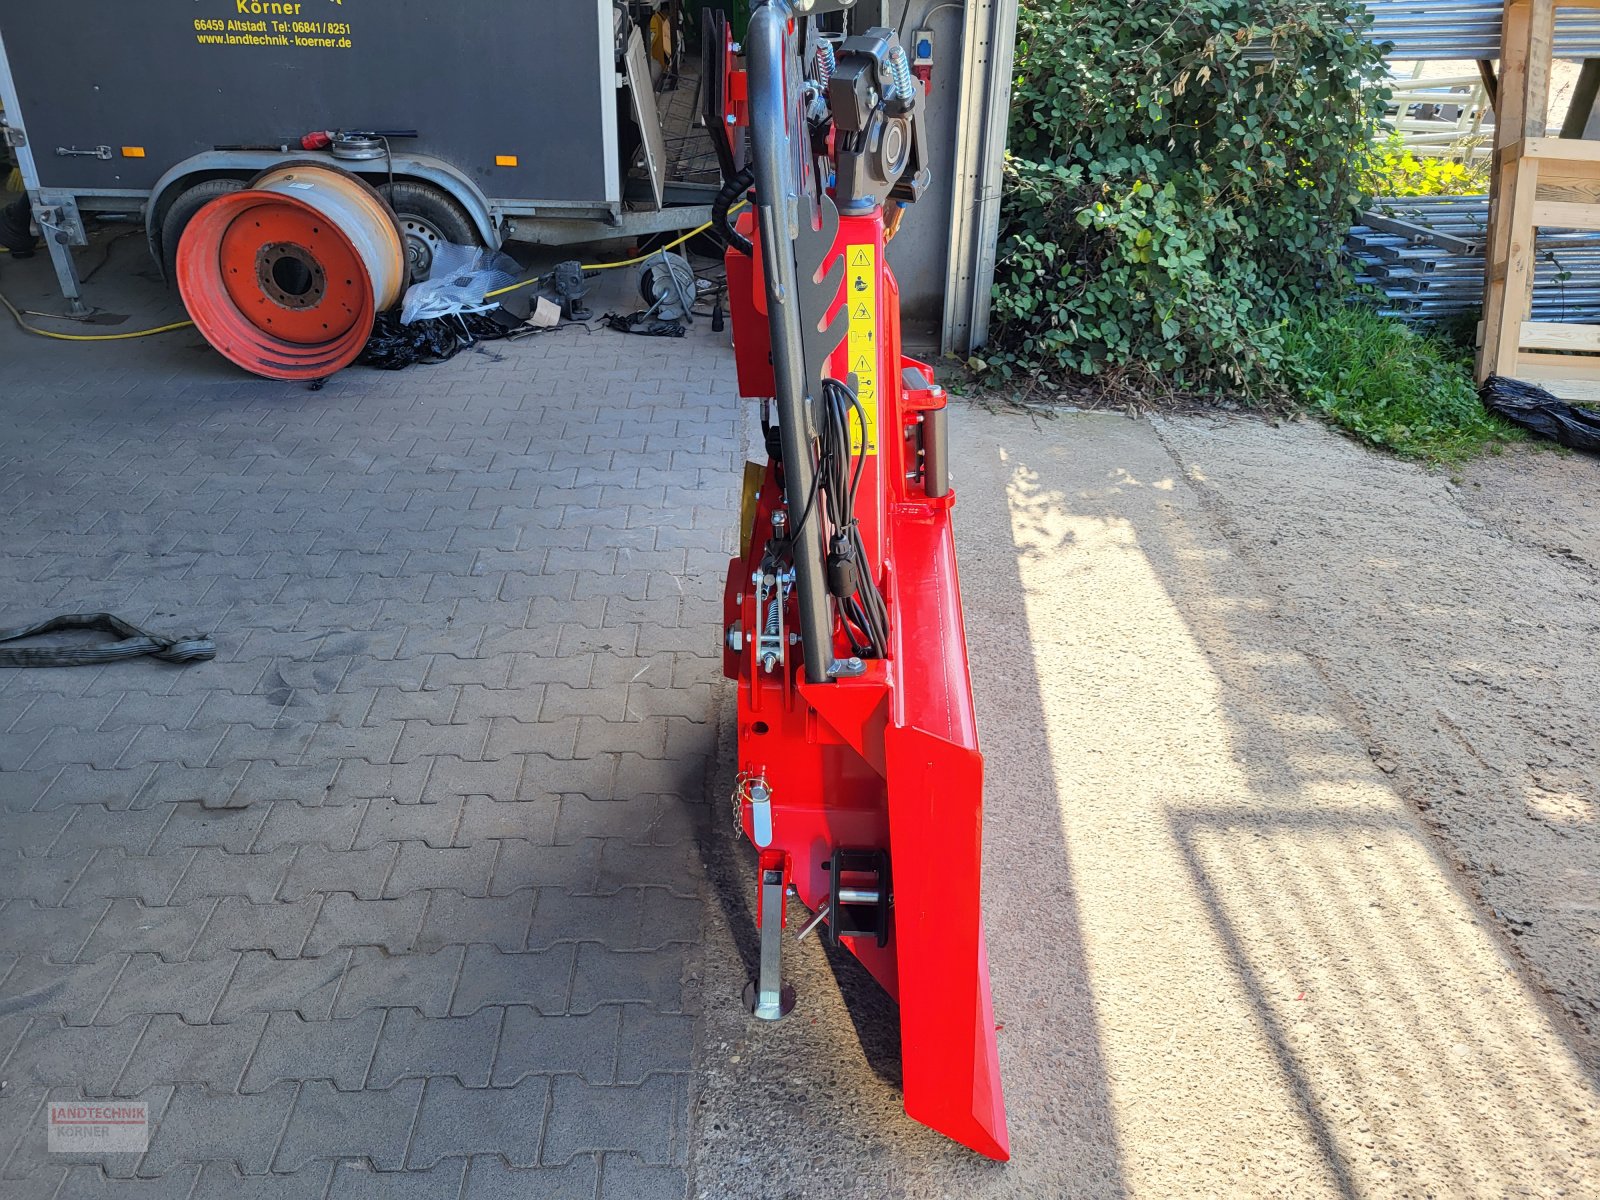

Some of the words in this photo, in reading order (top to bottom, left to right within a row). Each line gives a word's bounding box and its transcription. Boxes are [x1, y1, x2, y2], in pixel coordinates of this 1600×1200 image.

[236, 0, 301, 15] Körner
[193, 19, 225, 31] 66459
[227, 20, 267, 32] Altstadt
[197, 34, 352, 48] www.landtechnik-koerner.de
